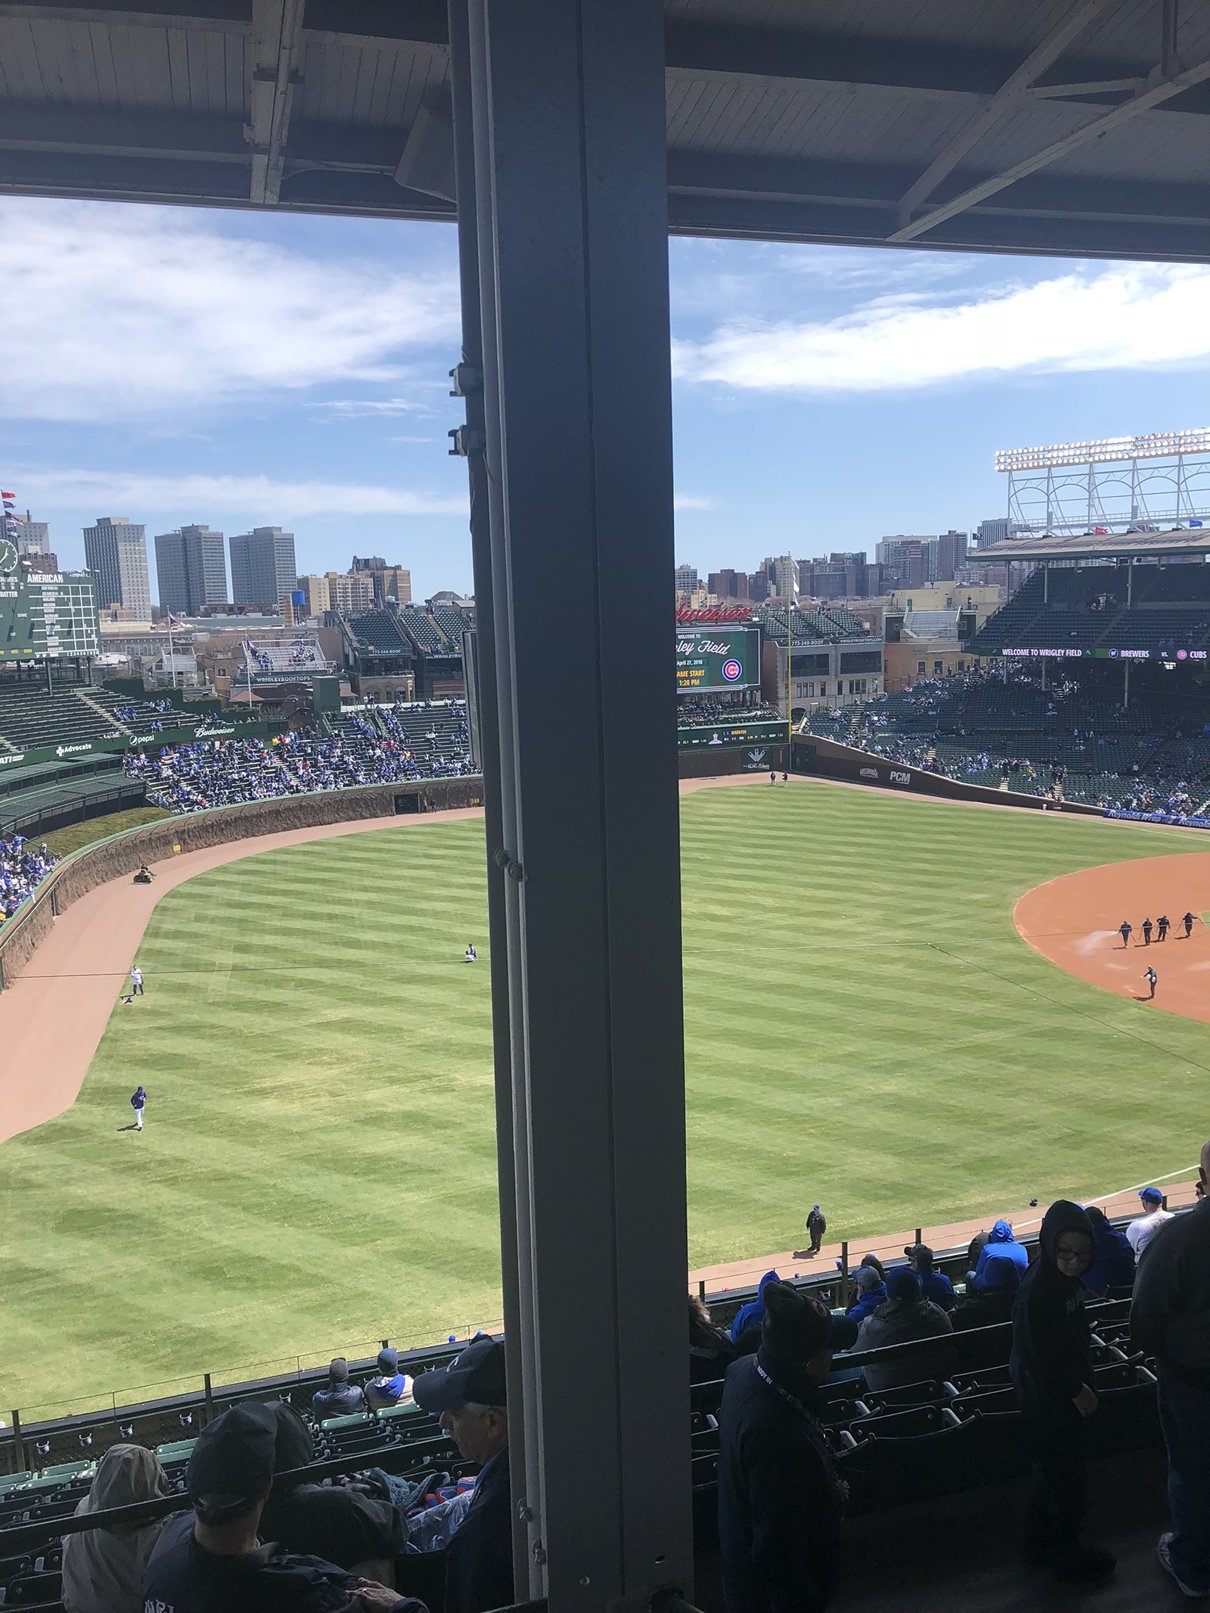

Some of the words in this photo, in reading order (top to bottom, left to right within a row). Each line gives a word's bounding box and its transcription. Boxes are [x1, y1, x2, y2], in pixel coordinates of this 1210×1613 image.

[27, 574, 64, 583] AMERICAN
[675, 640, 695, 655] ley
[697, 640, 731, 655] Field
[1065, 649, 1083, 657] FIELD
[1120, 650, 1150, 658] BREWERS
[1189, 651, 1207, 659] CUBS
[193, 726, 235, 738] Budweiser
[137, 734, 155, 744] pepsi
[64, 743, 92, 753] Advocate
[889, 770, 911, 782] PCM
[1108, 809, 1142, 820] Reynolds
